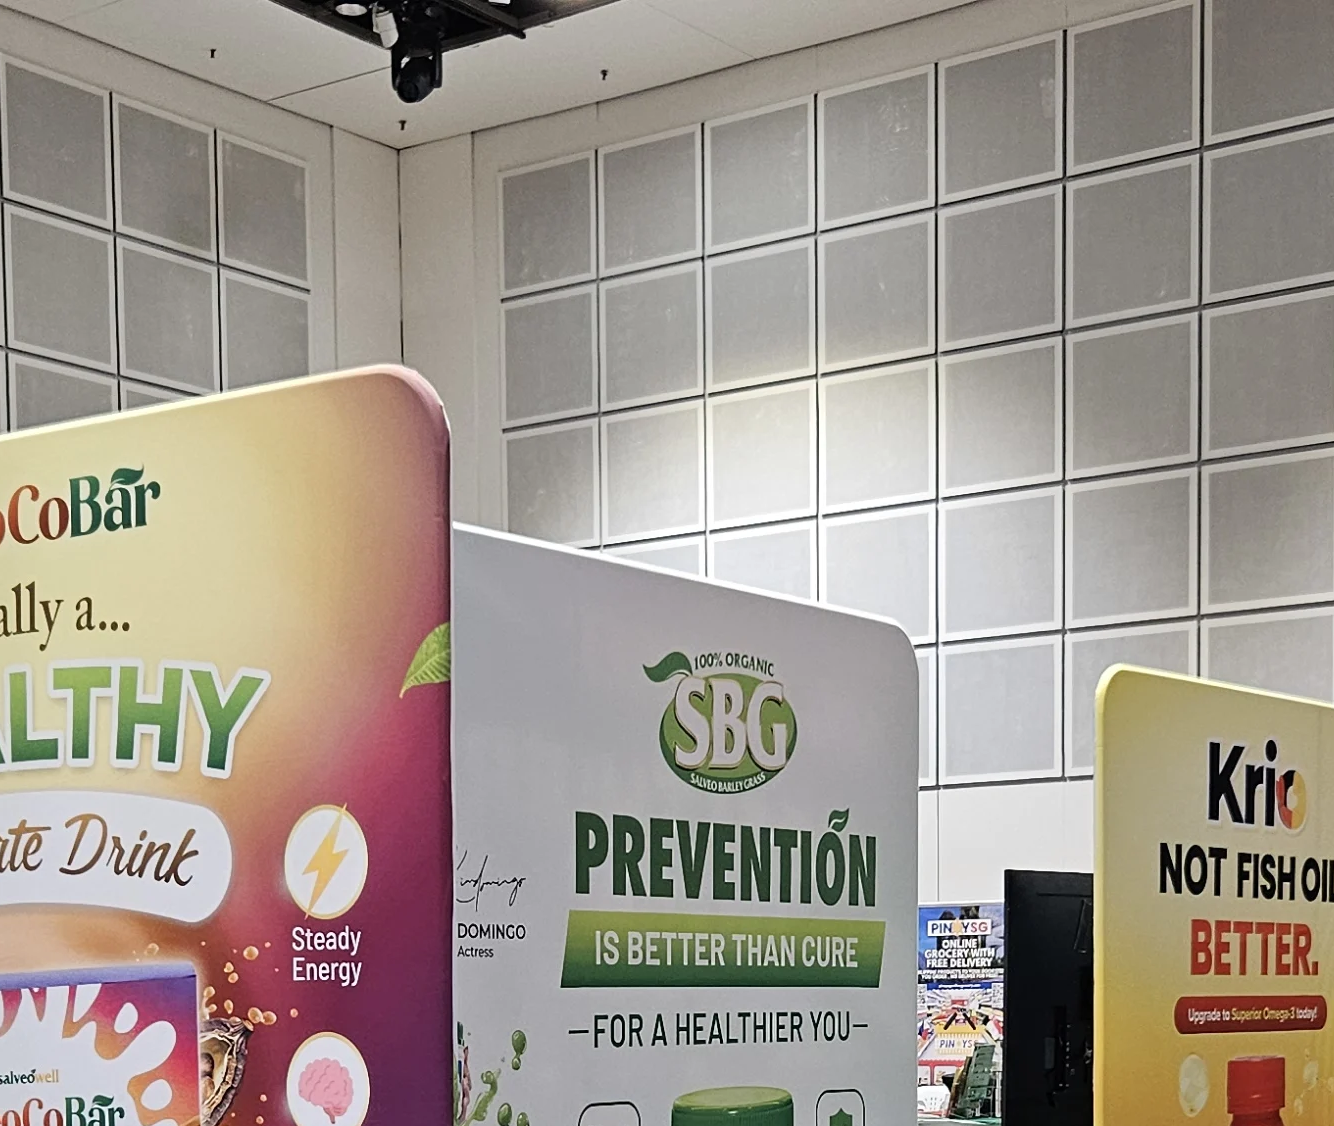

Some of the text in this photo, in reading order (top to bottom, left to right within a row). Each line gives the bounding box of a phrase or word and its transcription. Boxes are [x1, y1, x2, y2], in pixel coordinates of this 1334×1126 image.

[74, 592, 131, 633] a...
[694, 652, 774, 677] 100% ORGANIC
[675, 676, 787, 772] SBG
[690, 772, 766, 792] SALVEO BARLEY GRASS
[60, 812, 200, 894] Drink
[575, 809, 877, 907] PREVENTION
[1159, 842, 1227, 897] NOT
[1237, 852, 1296, 901] FISH
[292, 926, 362, 956] Steady
[457, 923, 526, 940] DOMINGO
[942, 939, 977, 948] ONLINE
[457, 946, 494, 957] Actress
[595, 930, 859, 968] IS BETTER THAN CURE
[925, 948, 995, 958] GROCERY WITH
[1190, 918, 1319, 976] BETTER.
[293, 958, 362, 987] Energy
[927, 958, 993, 968] FREE DELIVERY
[594, 1011, 851, 1048] FOR A HEALTHIER YOU
[1188, 1007, 1317, 1025] Upgrade to Superior Omega-3 today!
